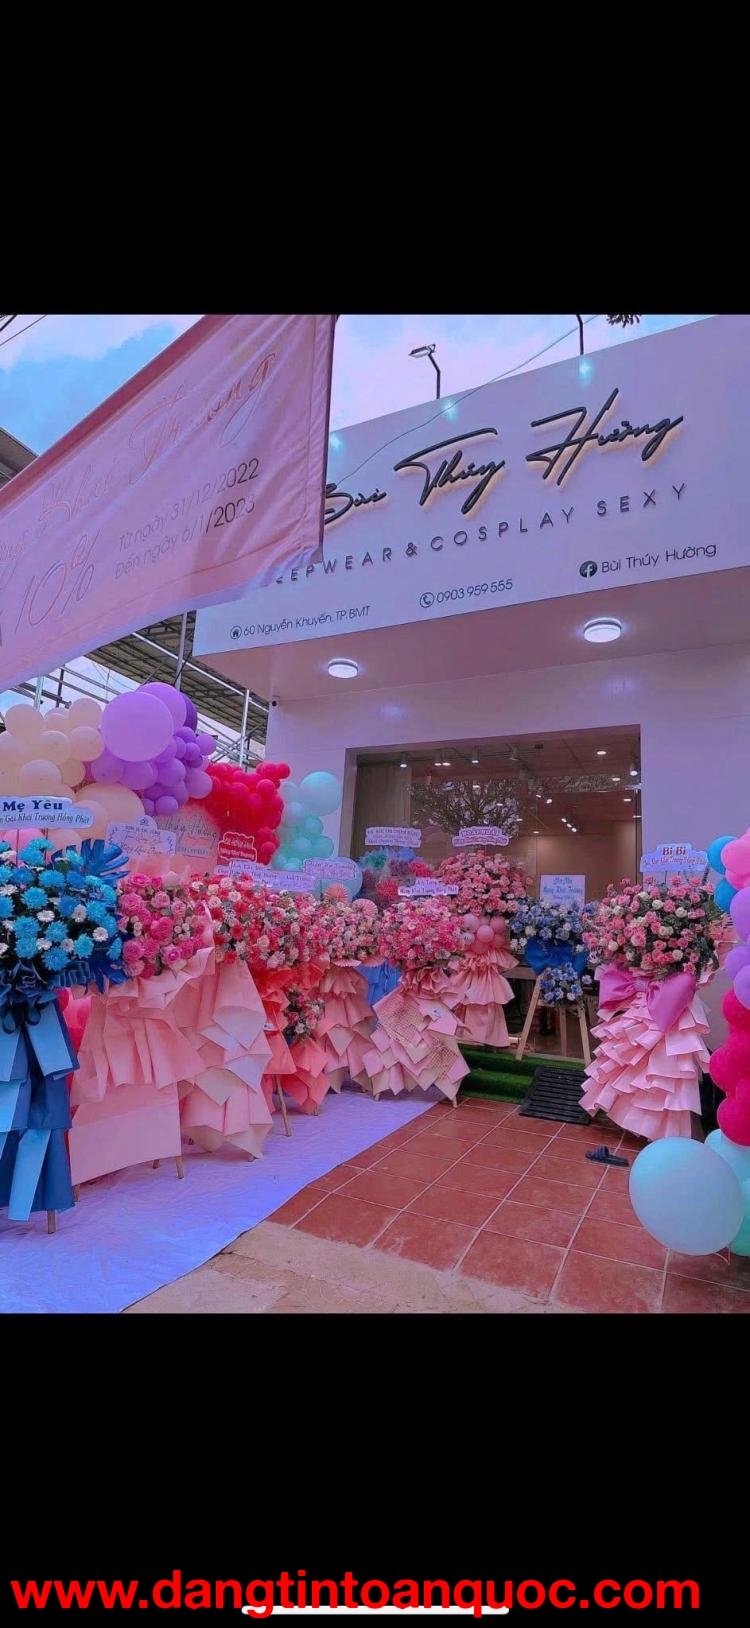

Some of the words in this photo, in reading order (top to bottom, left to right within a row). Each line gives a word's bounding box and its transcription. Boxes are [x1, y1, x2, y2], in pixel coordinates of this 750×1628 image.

[394, 427, 504, 515] Thúy
[526, 387, 683, 486] Hường
[405, 541, 418, 557] &
[430, 506, 575, 551] COSPLAY
[596, 483, 686, 516] SEXY
[601, 558, 621, 573] Bùi
[625, 550, 660, 570] Thúy
[665, 544, 717, 564] Hường
[436, 588, 465, 604] 0903
[467, 582, 489, 598] 959
[490, 578, 513, 593] 555
[243, 623, 256, 637] 60
[257, 618, 293, 635] Nguyễn
[335, 605, 371, 621] TP.BMT
[3, 801, 25, 813] Mẹ
[31, 799, 63, 810] Yêu
[662, 847, 673, 856] Bi
[676, 846, 686, 855] Bi
